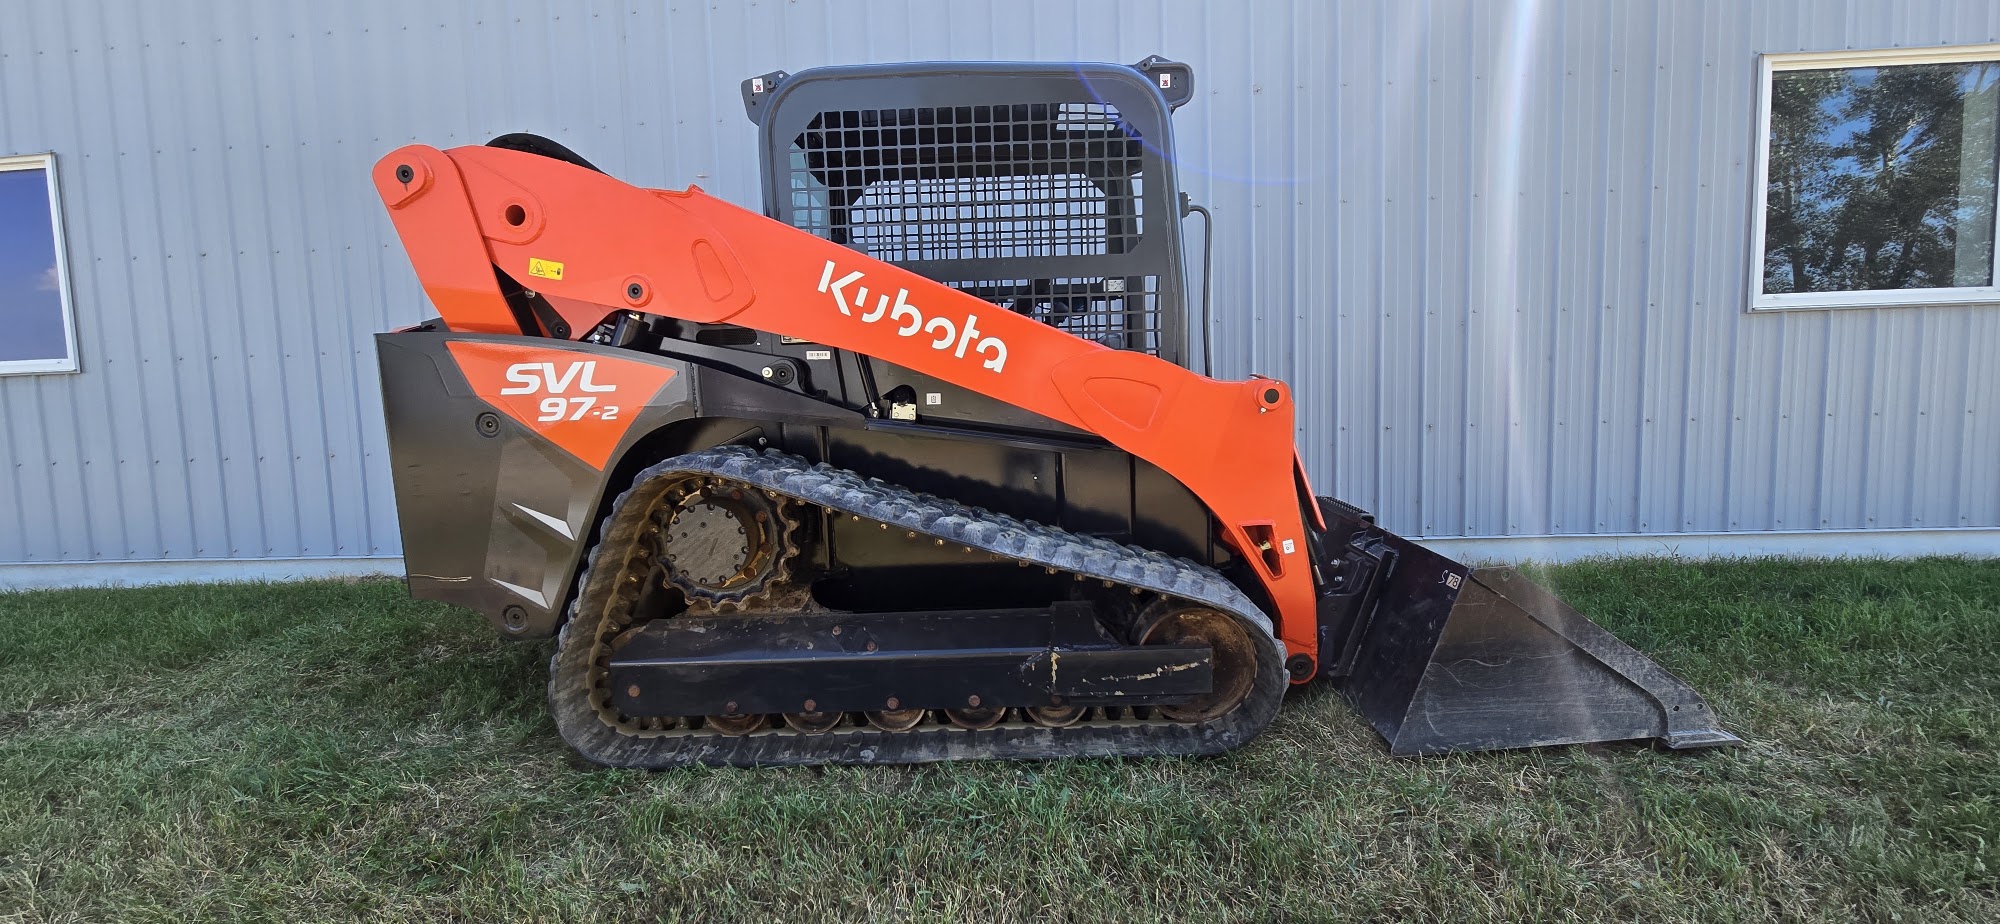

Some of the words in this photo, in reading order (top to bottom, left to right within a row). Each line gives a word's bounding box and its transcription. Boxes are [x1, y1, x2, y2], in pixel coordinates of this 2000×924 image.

[817, 259, 1008, 374] Kubota
[500, 361, 617, 395] SVL
[537, 396, 620, 422] 97-2
[1447, 573, 1460, 588] 78
